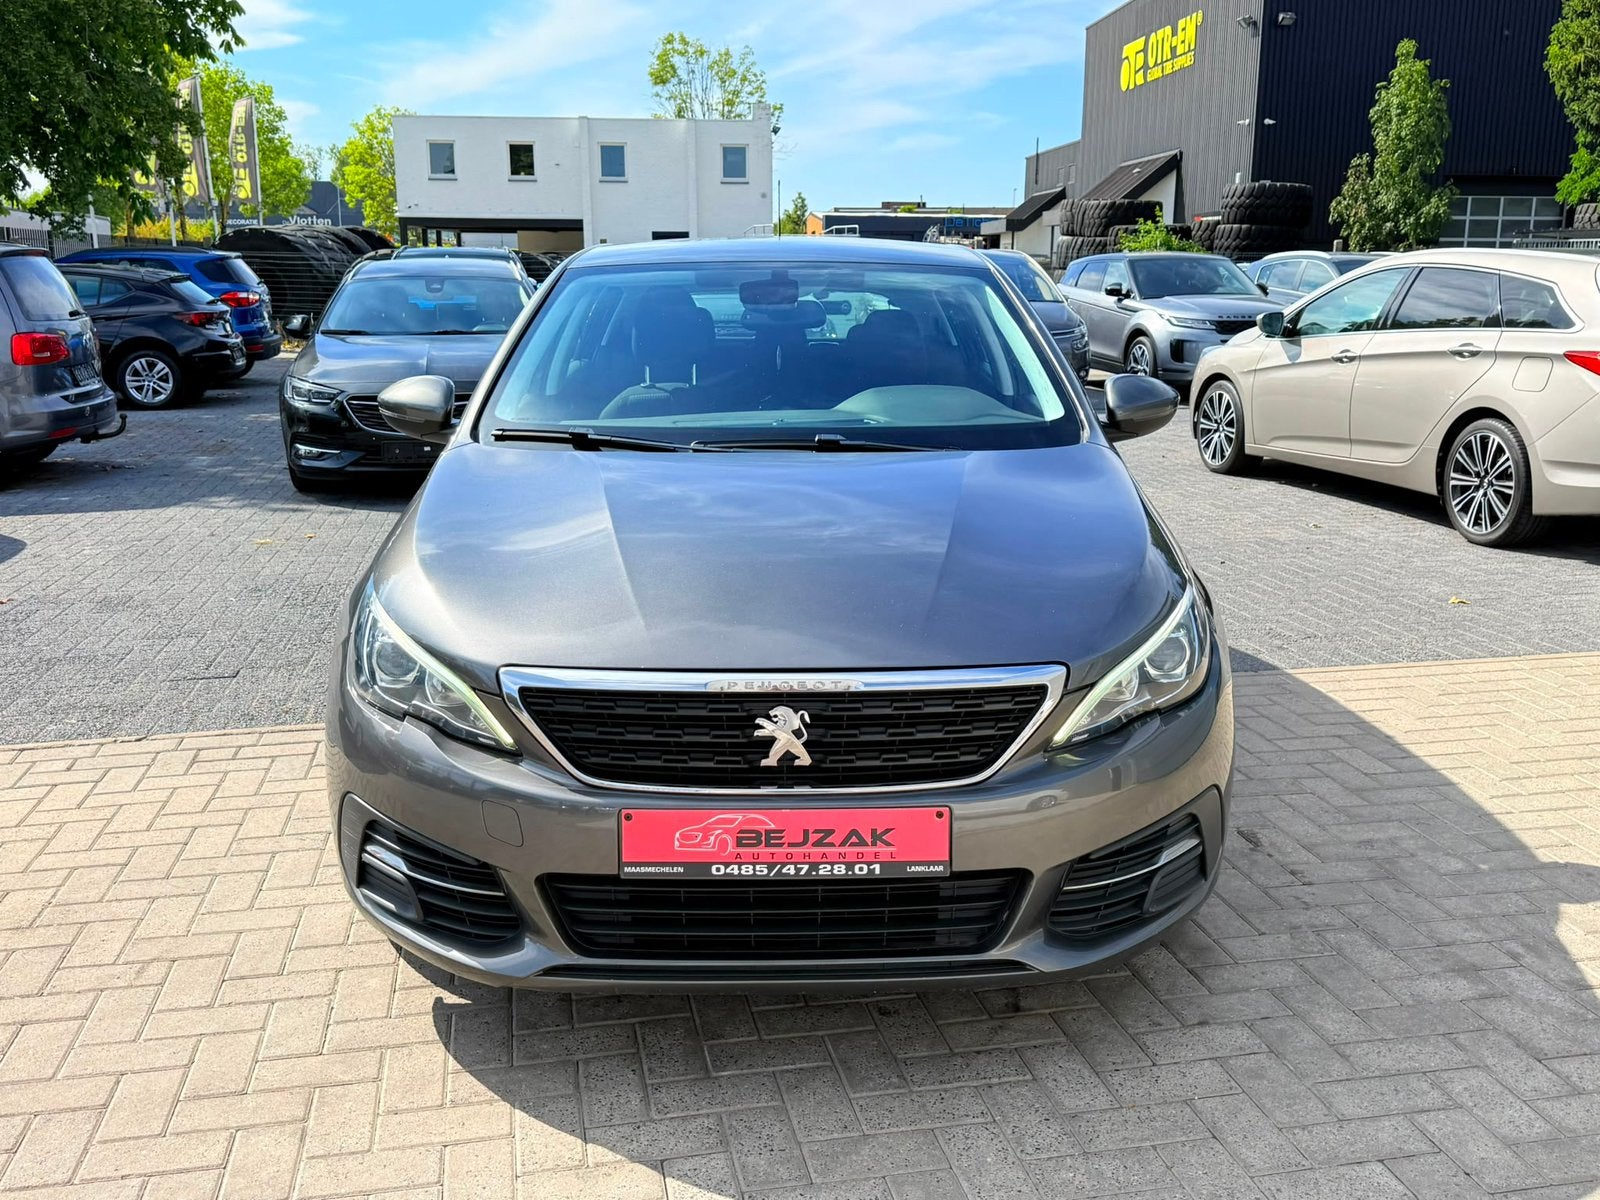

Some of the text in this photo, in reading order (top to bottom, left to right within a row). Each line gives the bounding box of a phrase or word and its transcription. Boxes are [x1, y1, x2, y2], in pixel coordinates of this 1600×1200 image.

[288, 215, 332, 226] Vlotten
[727, 681, 843, 691] PEUGEOT
[736, 828, 896, 848] BEJZAK
[735, 851, 896, 860] AUTOHANDEL
[711, 863, 881, 876] 0485/47.28.01
